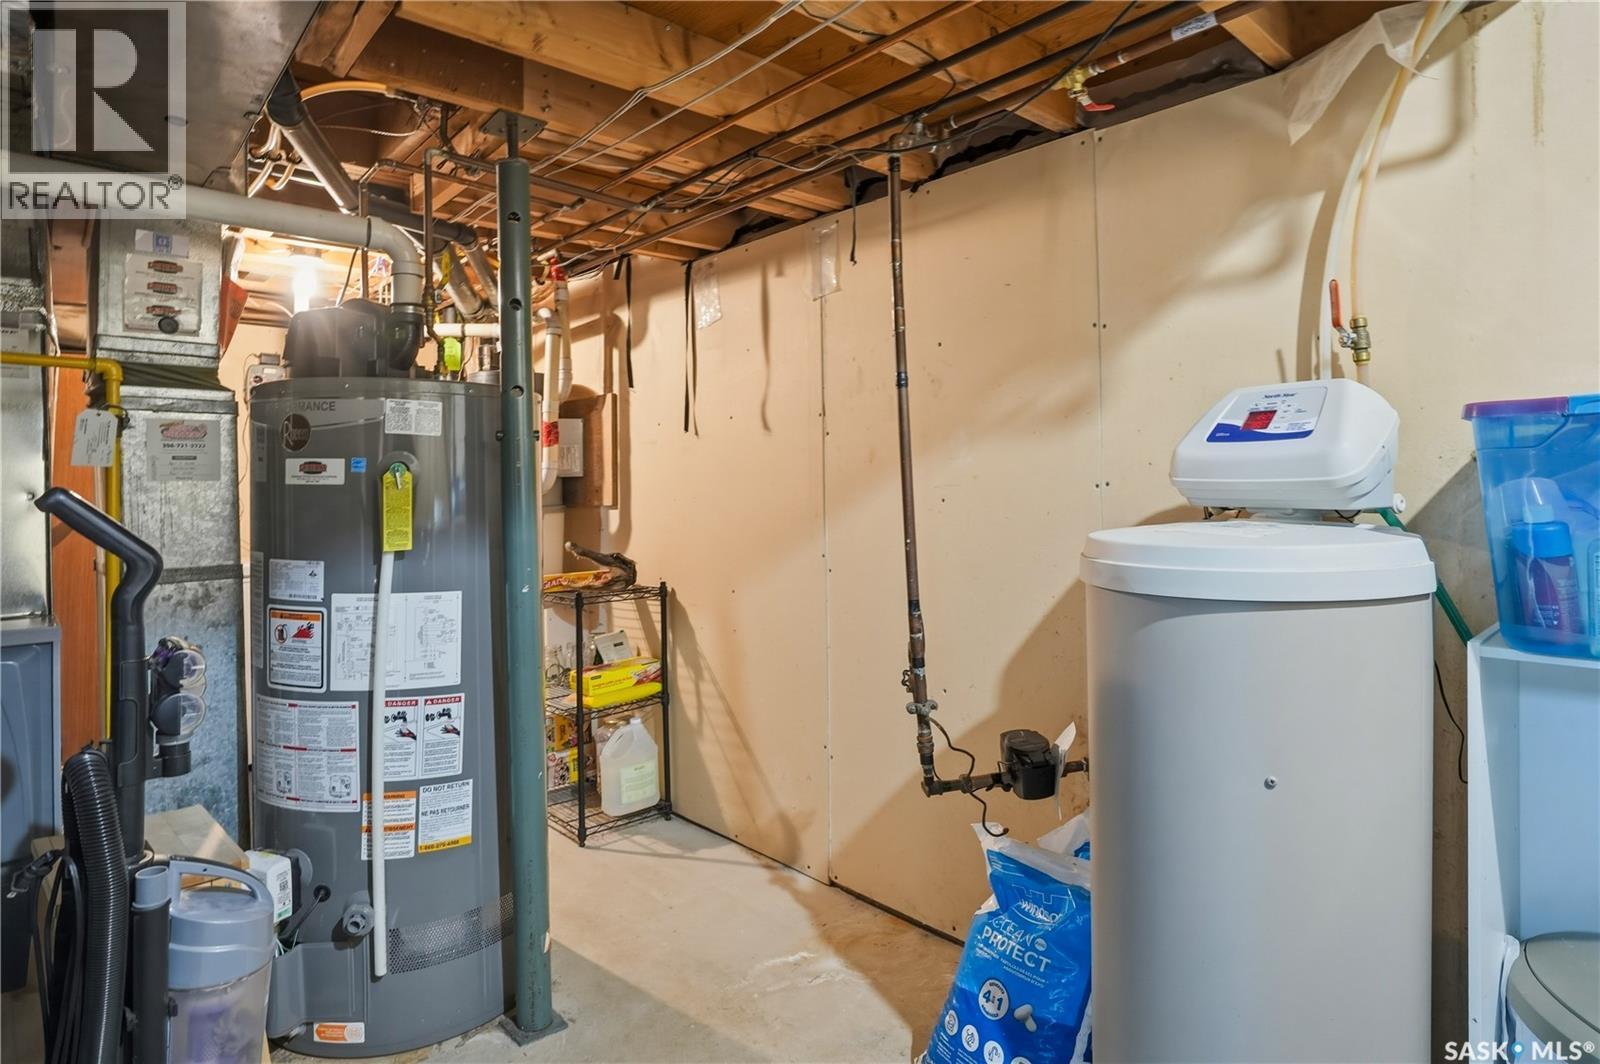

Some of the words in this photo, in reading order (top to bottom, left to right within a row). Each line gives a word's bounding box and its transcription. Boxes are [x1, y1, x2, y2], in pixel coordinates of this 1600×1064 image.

[433, 784, 446, 792] NOT
[446, 781, 470, 789] RETURN
[990, 915, 1036, 947] CLEAN
[982, 925, 1052, 973] PROTECT
